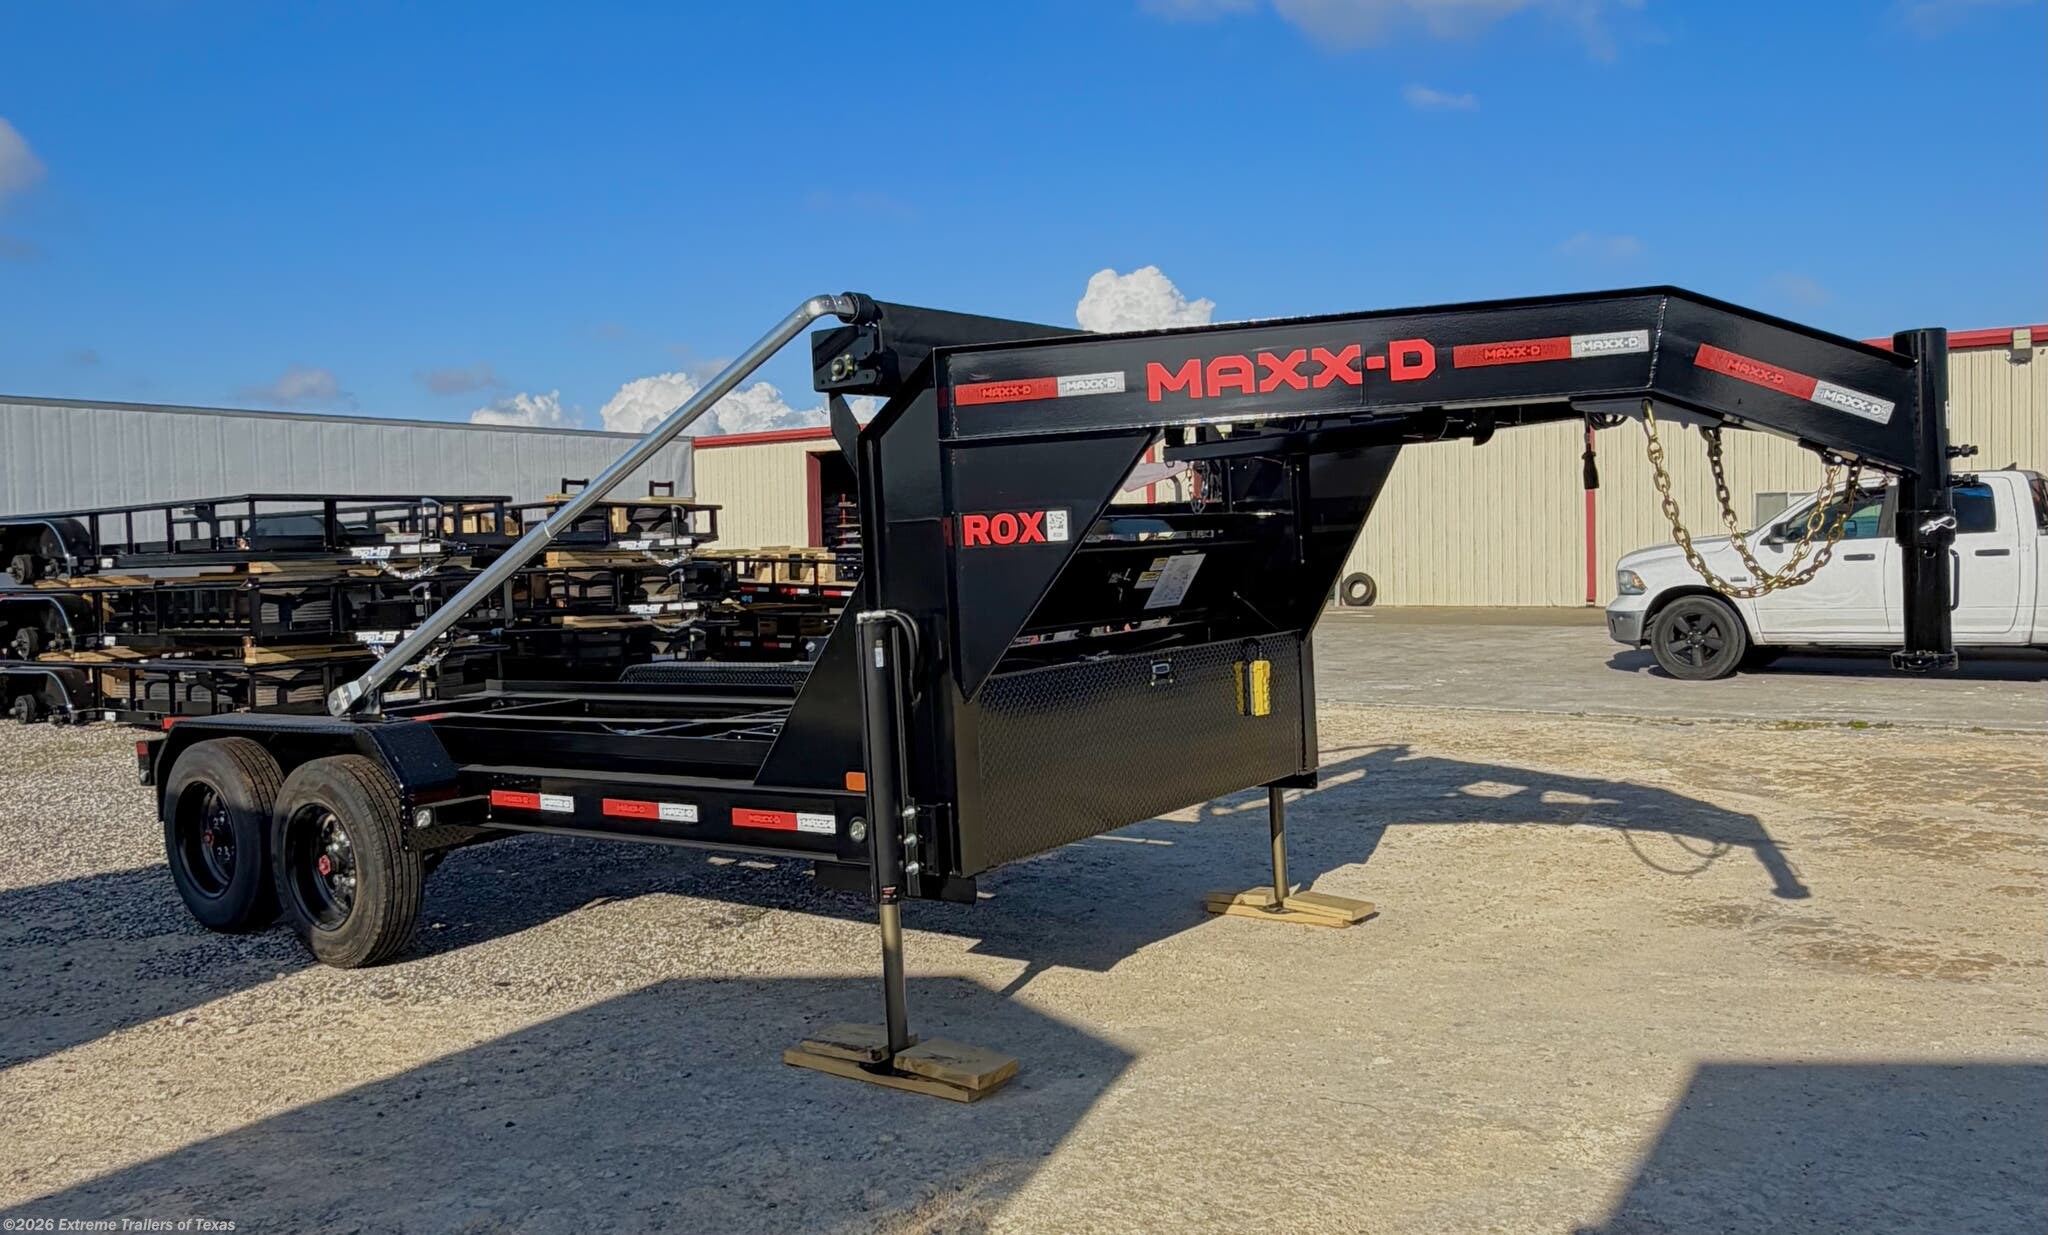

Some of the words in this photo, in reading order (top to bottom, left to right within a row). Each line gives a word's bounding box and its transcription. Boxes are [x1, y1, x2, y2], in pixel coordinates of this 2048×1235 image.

[1484, 345, 1542, 361] MAXX-D
[1581, 336, 1638, 352] MAXX-D
[1147, 338, 1437, 402] MAXX-D
[1726, 358, 1785, 385] MAXX-D
[982, 383, 1032, 399] MAXX-D
[1066, 376, 1117, 391] MAXX-D
[1823, 388, 1882, 415] MAXX-D
[963, 511, 1046, 547] ROX
